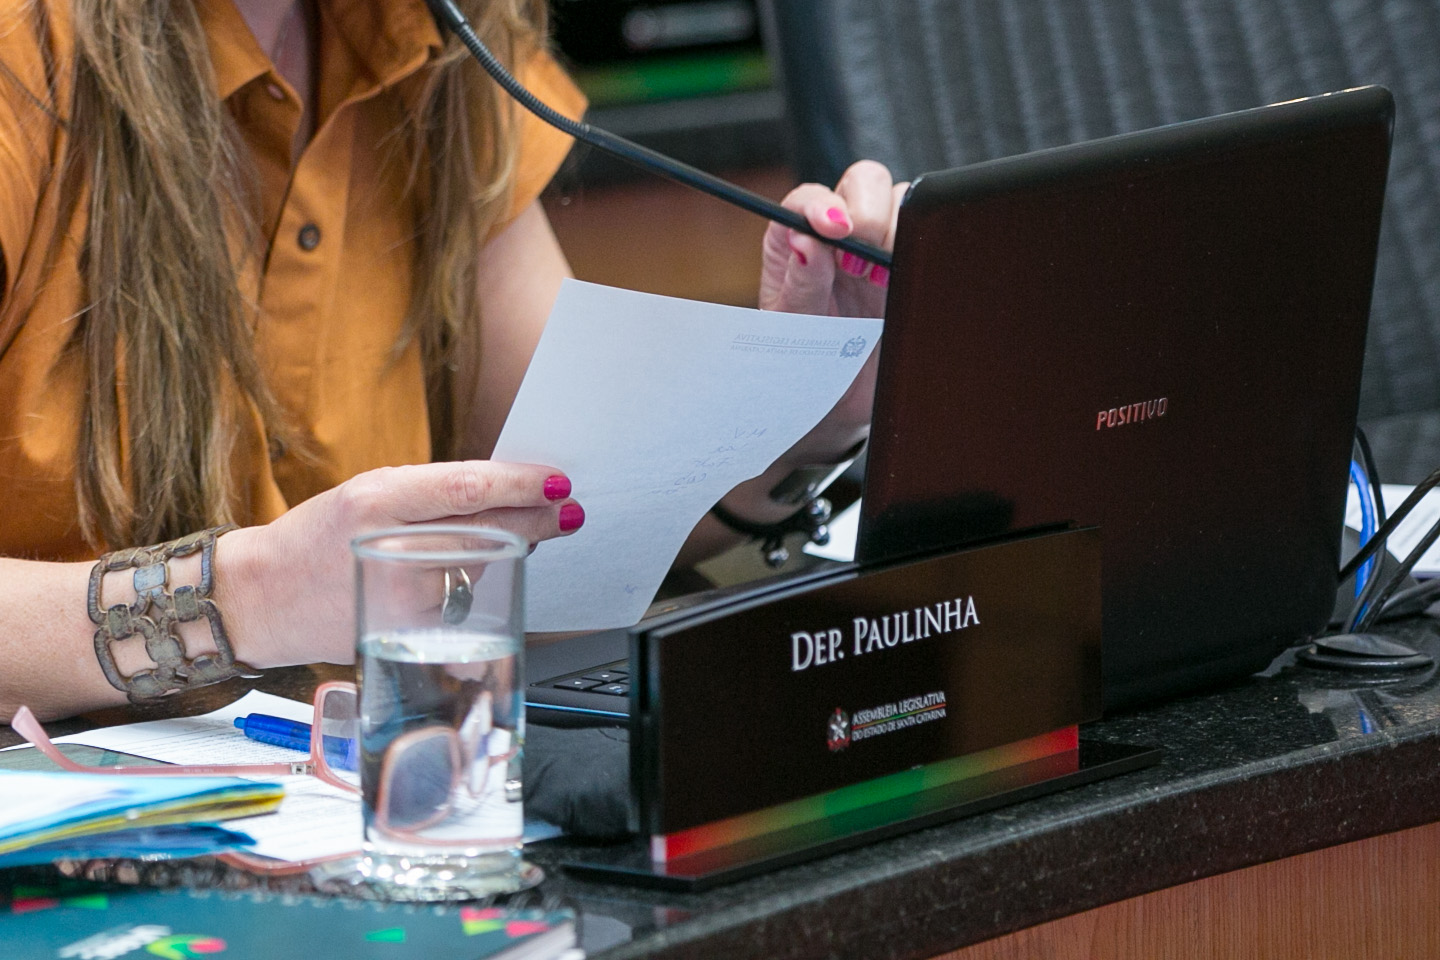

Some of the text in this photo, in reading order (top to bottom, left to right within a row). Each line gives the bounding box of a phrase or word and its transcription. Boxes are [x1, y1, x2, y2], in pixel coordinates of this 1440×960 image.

[1096, 397, 1168, 430] POSITIVO
[790, 595, 980, 672] DEP. PAULINHA
[851, 691, 945, 725] ASSEMBLEIA LEGISLATIVA
[864, 723, 887, 739] ESTADO
[896, 716, 916, 730] SANTA
[916, 708, 947, 724] CATARINA
